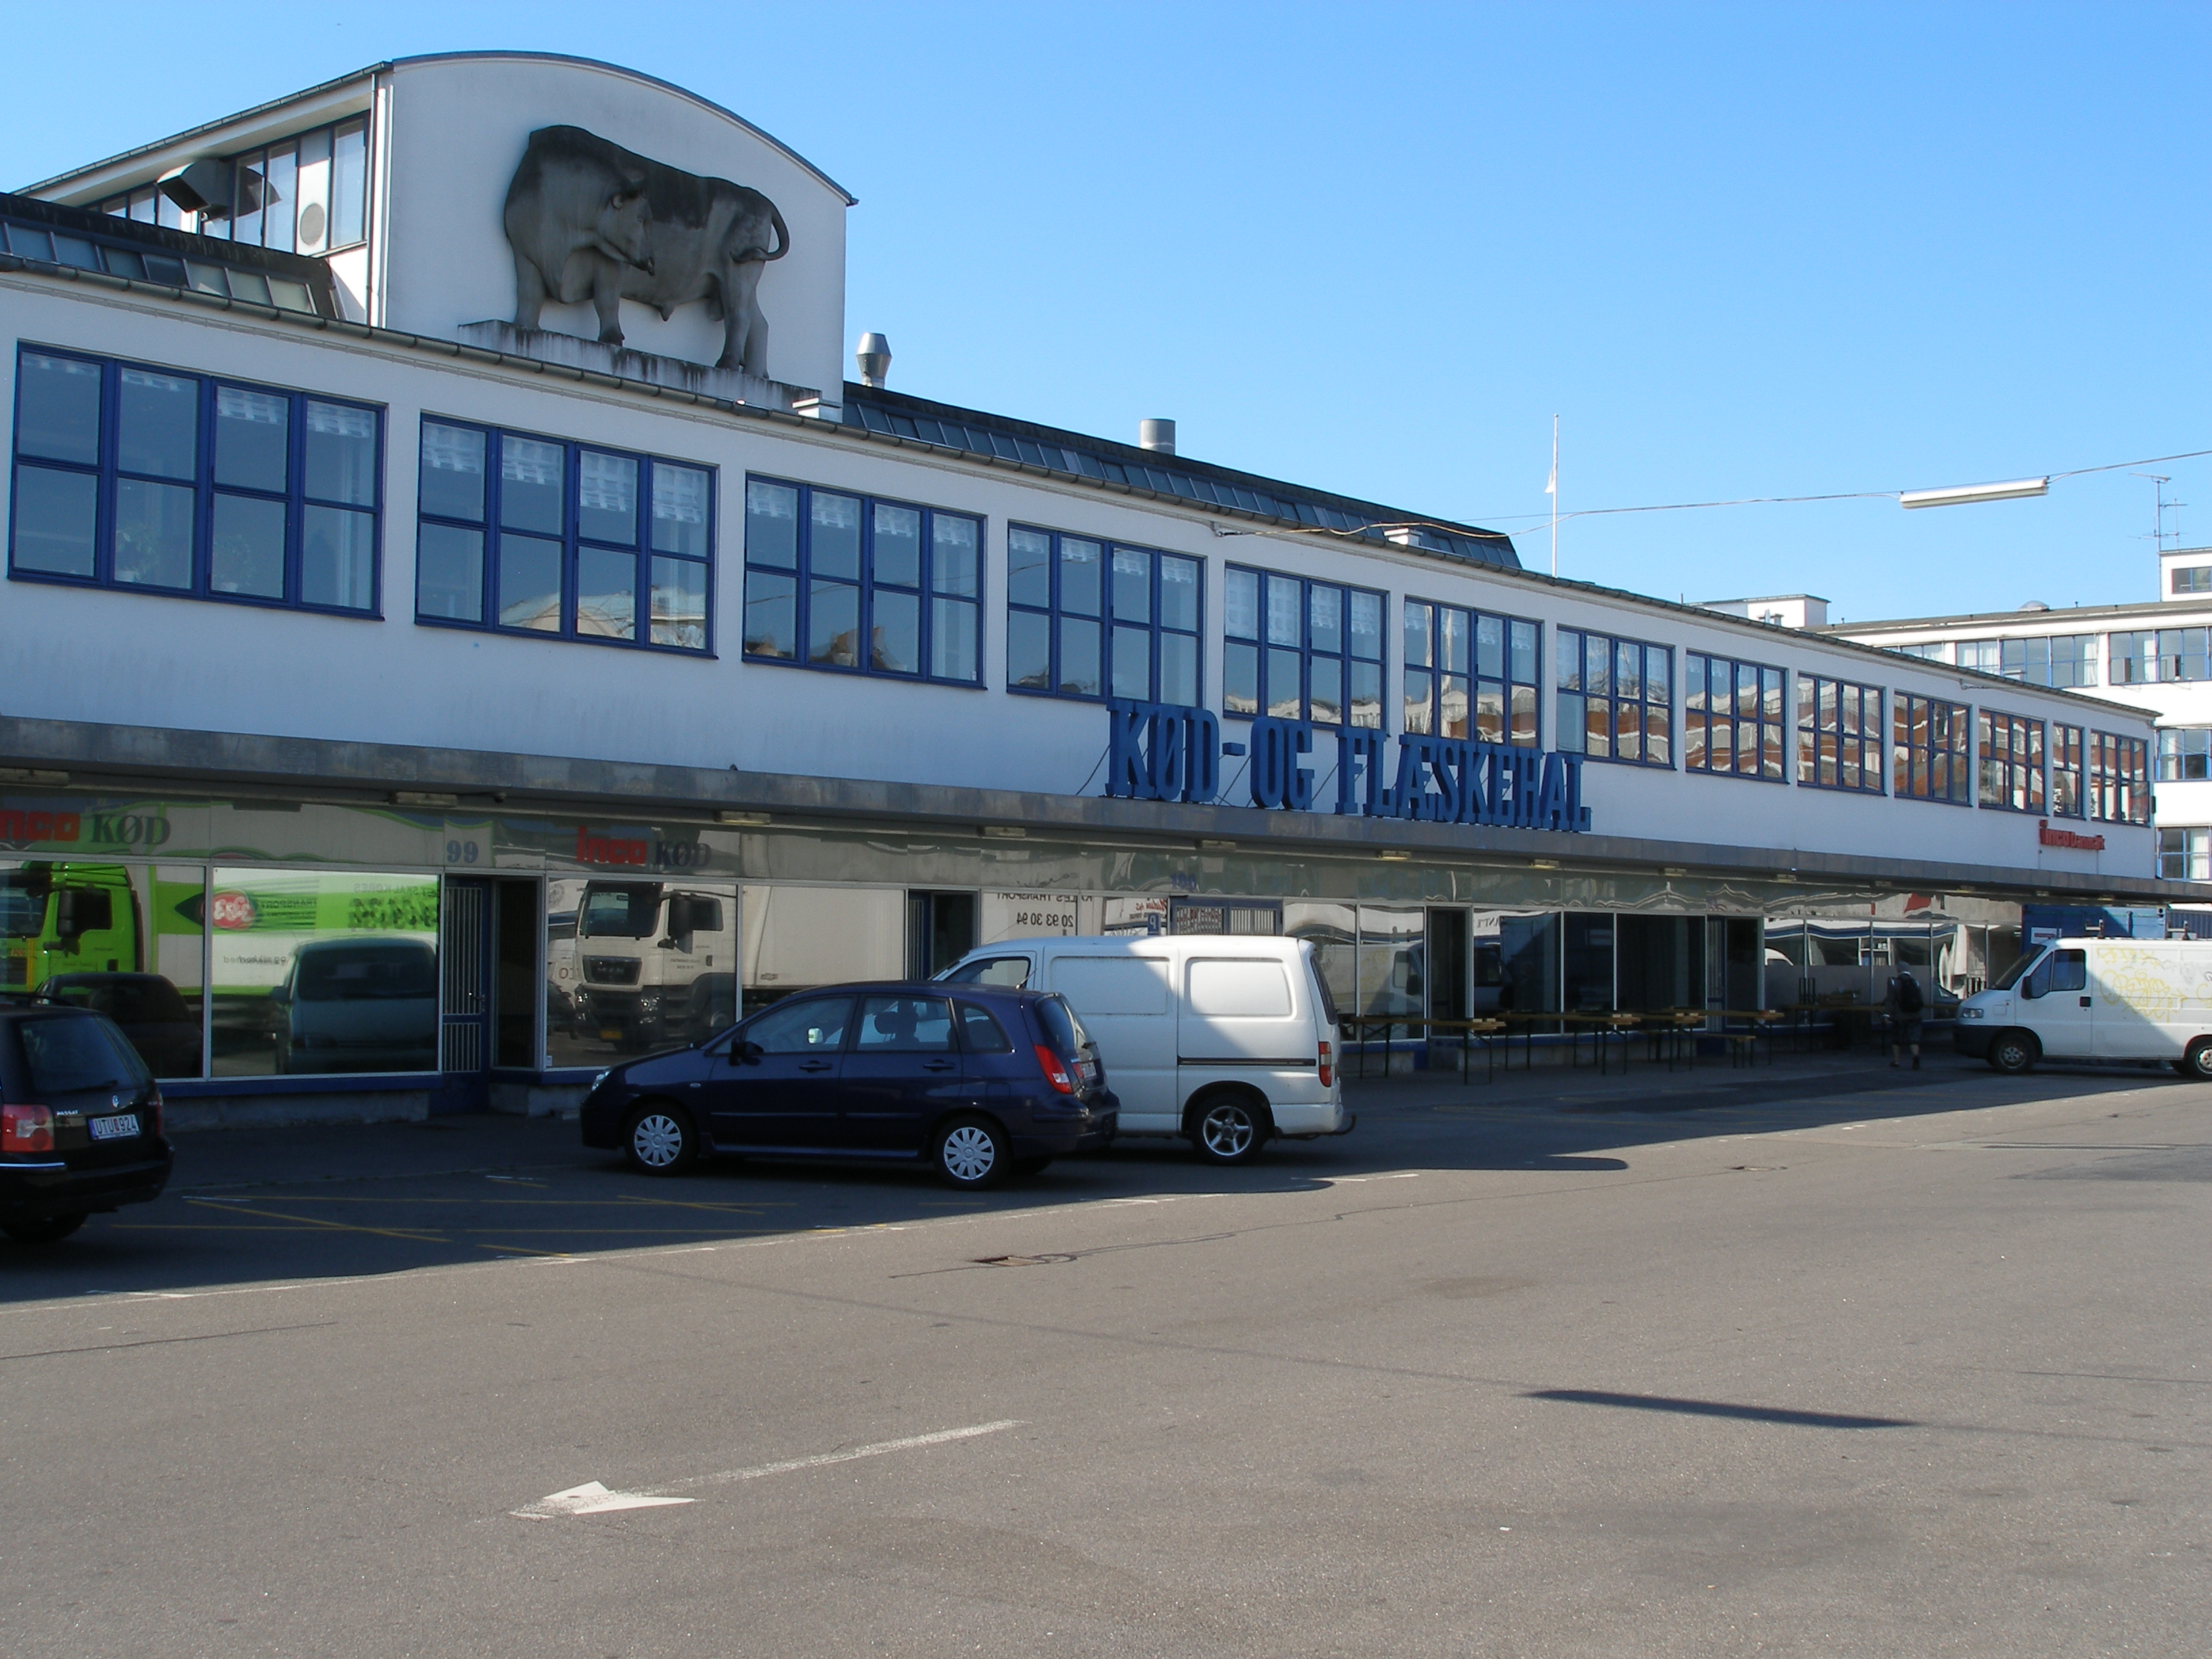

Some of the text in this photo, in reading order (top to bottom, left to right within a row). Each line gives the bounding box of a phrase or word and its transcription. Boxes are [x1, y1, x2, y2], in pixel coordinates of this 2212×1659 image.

[1335, 728, 1591, 832] FLÆSKEHAL
[0, 810, 171, 846] nco KØD
[445, 840, 479, 864] 99
[655, 840, 712, 867] KØD
